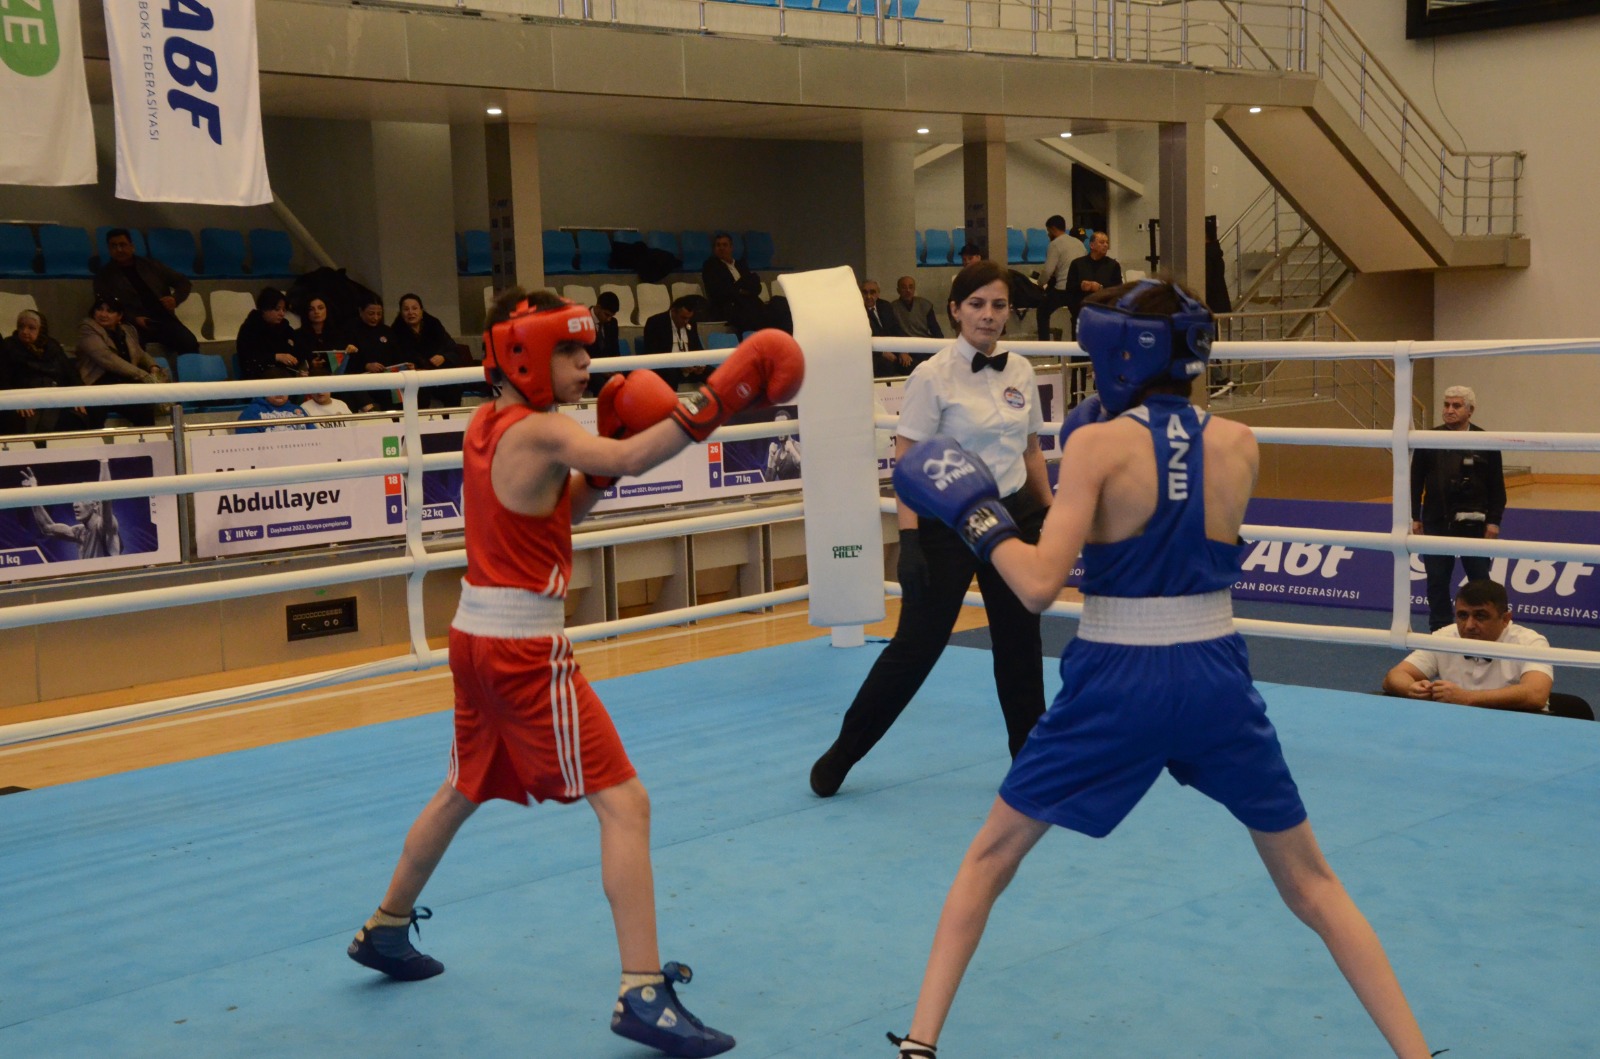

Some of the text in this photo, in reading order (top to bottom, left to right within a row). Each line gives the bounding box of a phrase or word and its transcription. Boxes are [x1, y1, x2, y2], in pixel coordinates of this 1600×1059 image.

[138, 1, 151, 39] BOKS
[162, 0, 222, 145] ABF
[385, 446, 397, 456] 69
[1167, 413, 1190, 500] AZE
[713, 471, 718, 479] 0
[742, 474, 751, 484] kq
[387, 476, 398, 485] 18
[217, 489, 341, 515] Abdullayev
[391, 505, 397, 514] 0
[422, 508, 443, 518] 92 kq
[244, 529, 258, 537] Yer
[6, 555, 20, 565] kq
[834, 551, 858, 559] HILL
[1258, 583, 1285, 593] BOKS
[1288, 585, 1360, 600] FEDERASİYASI
